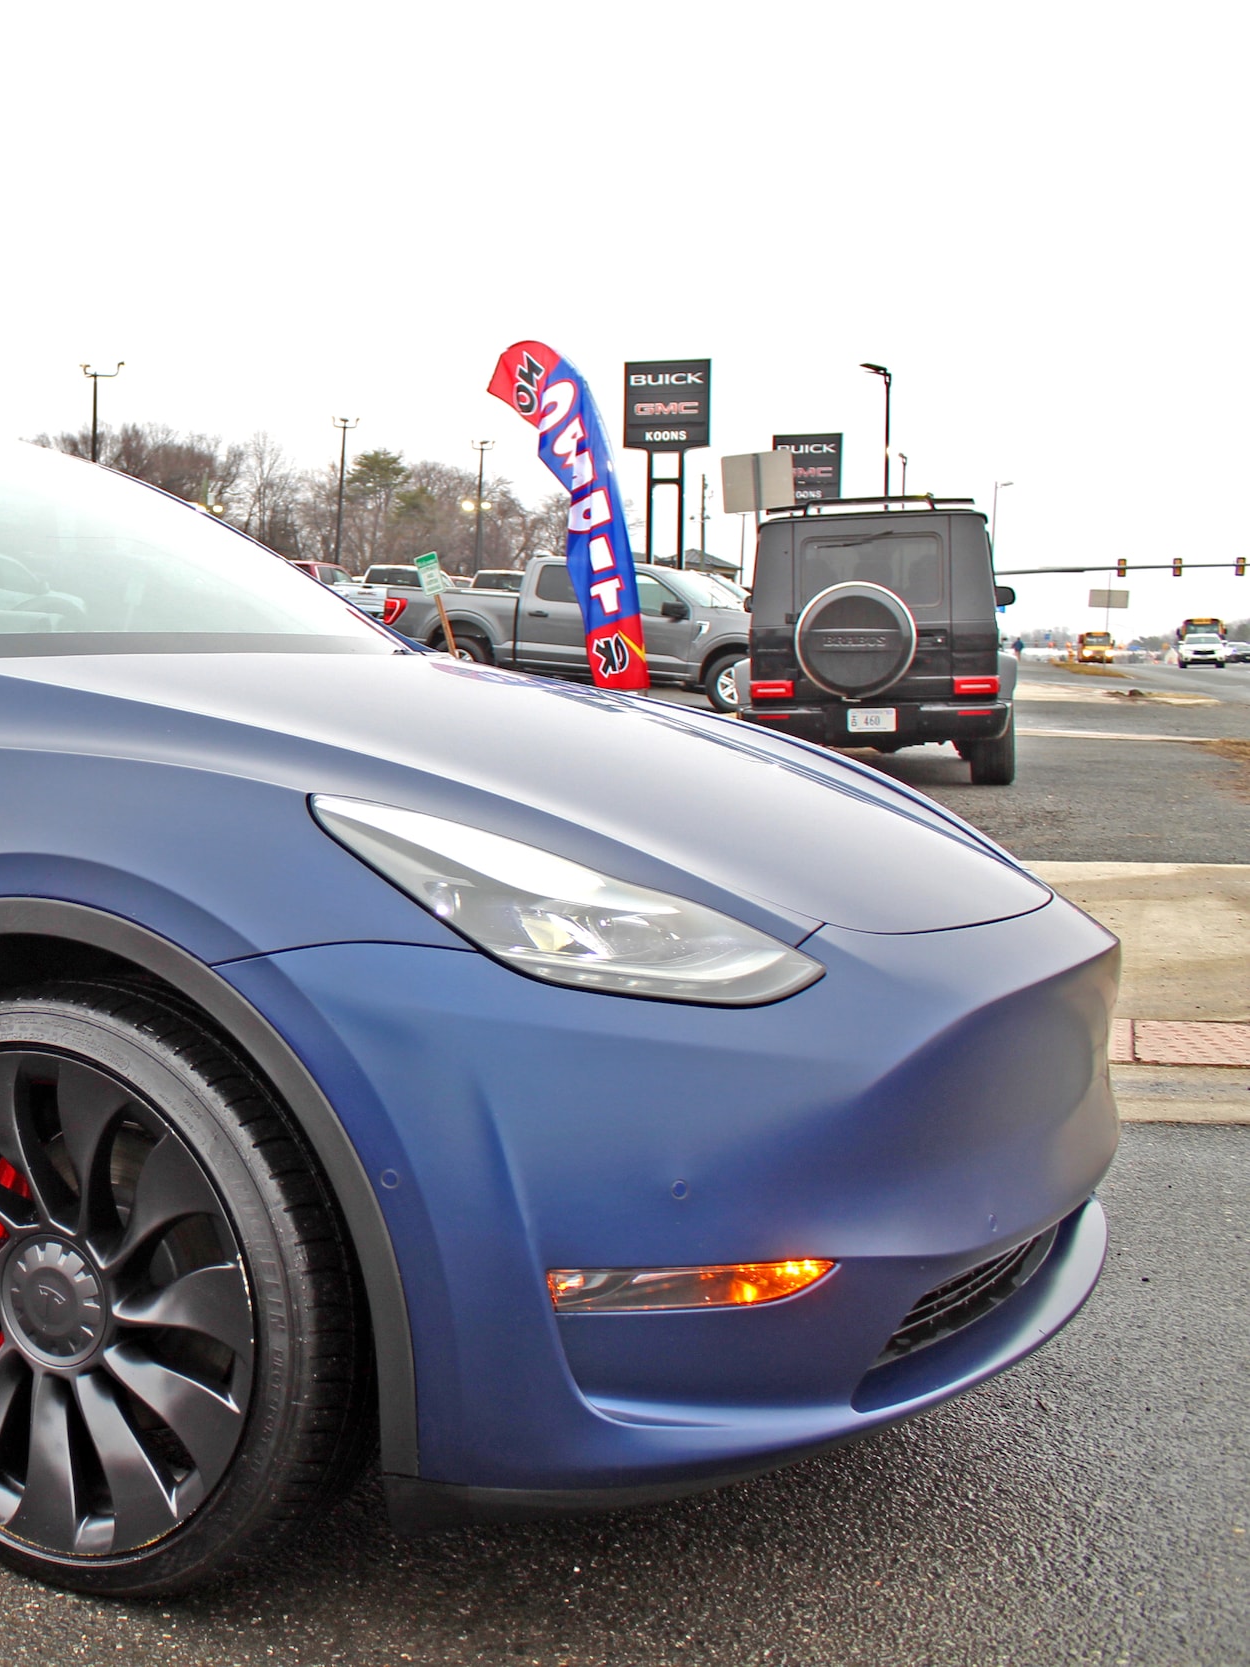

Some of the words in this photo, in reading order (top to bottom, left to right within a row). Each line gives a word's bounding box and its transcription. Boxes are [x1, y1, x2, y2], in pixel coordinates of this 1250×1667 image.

[630, 372, 704, 386] BUICK
[634, 402, 699, 415] GMC
[645, 430, 687, 441] KOONS
[792, 466, 833, 478] MC
[795, 490, 823, 499] OONS
[823, 635, 887, 648] BRABUS
